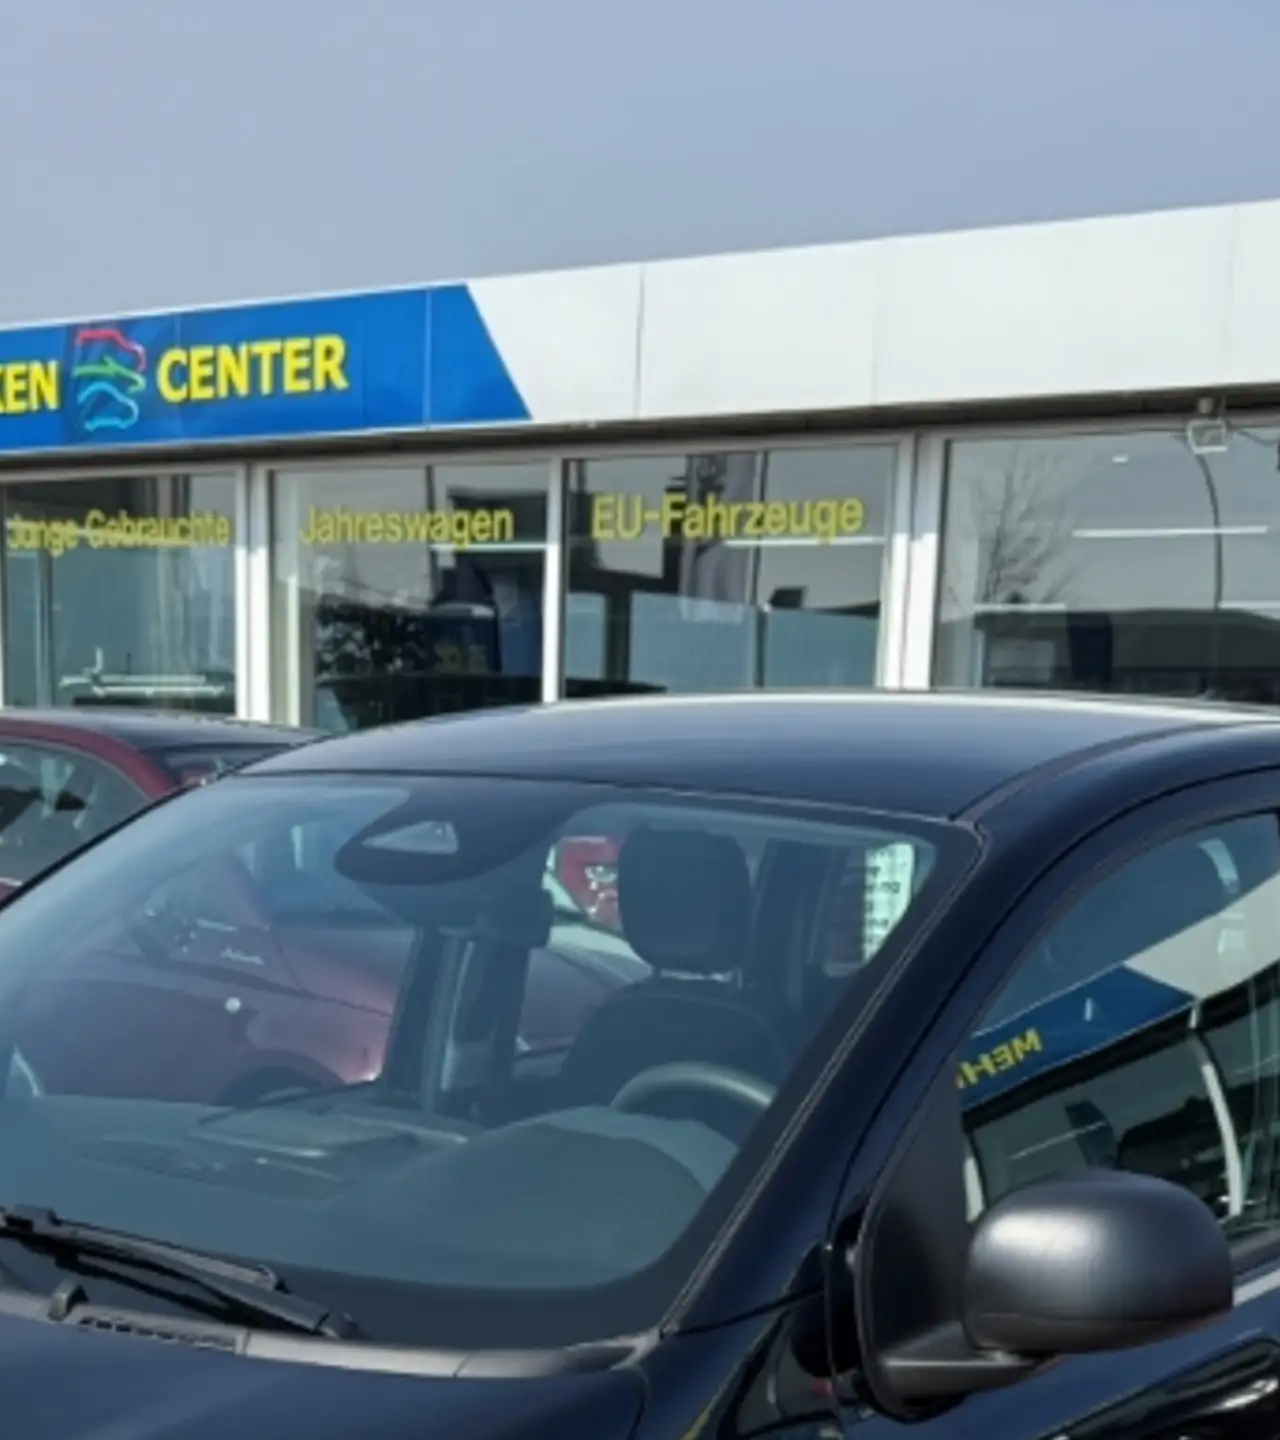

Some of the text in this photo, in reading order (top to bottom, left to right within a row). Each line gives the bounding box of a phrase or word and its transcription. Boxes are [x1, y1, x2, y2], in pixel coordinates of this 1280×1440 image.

[156, 334, 349, 403] CENTER
[299, 506, 514, 549] Jahreswagen
[591, 493, 864, 544] EU-Fahrzeuge
